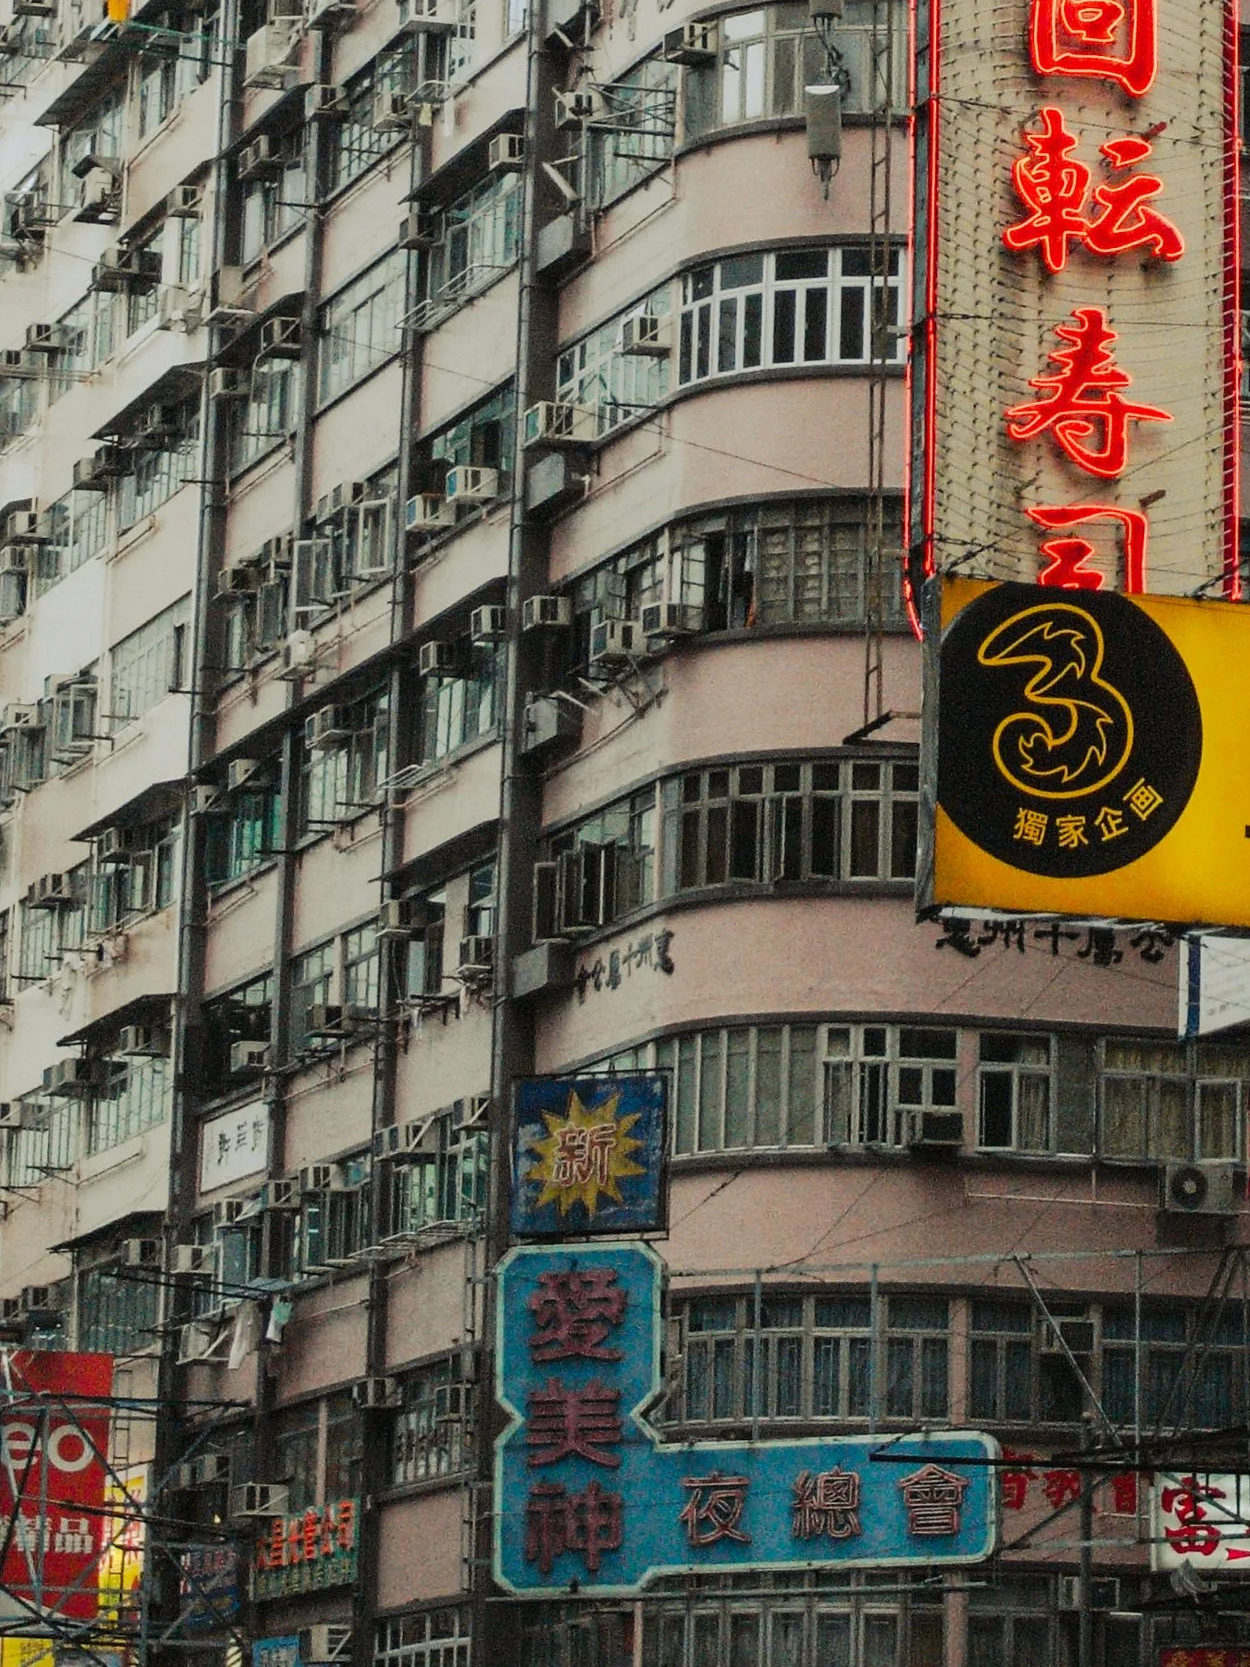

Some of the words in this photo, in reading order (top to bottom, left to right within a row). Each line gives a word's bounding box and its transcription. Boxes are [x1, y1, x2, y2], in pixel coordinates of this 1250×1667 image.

[552, 1121, 616, 1187] 新
[525, 1266, 629, 1574] 愛美神
[680, 1462, 970, 1547] 夜總會
